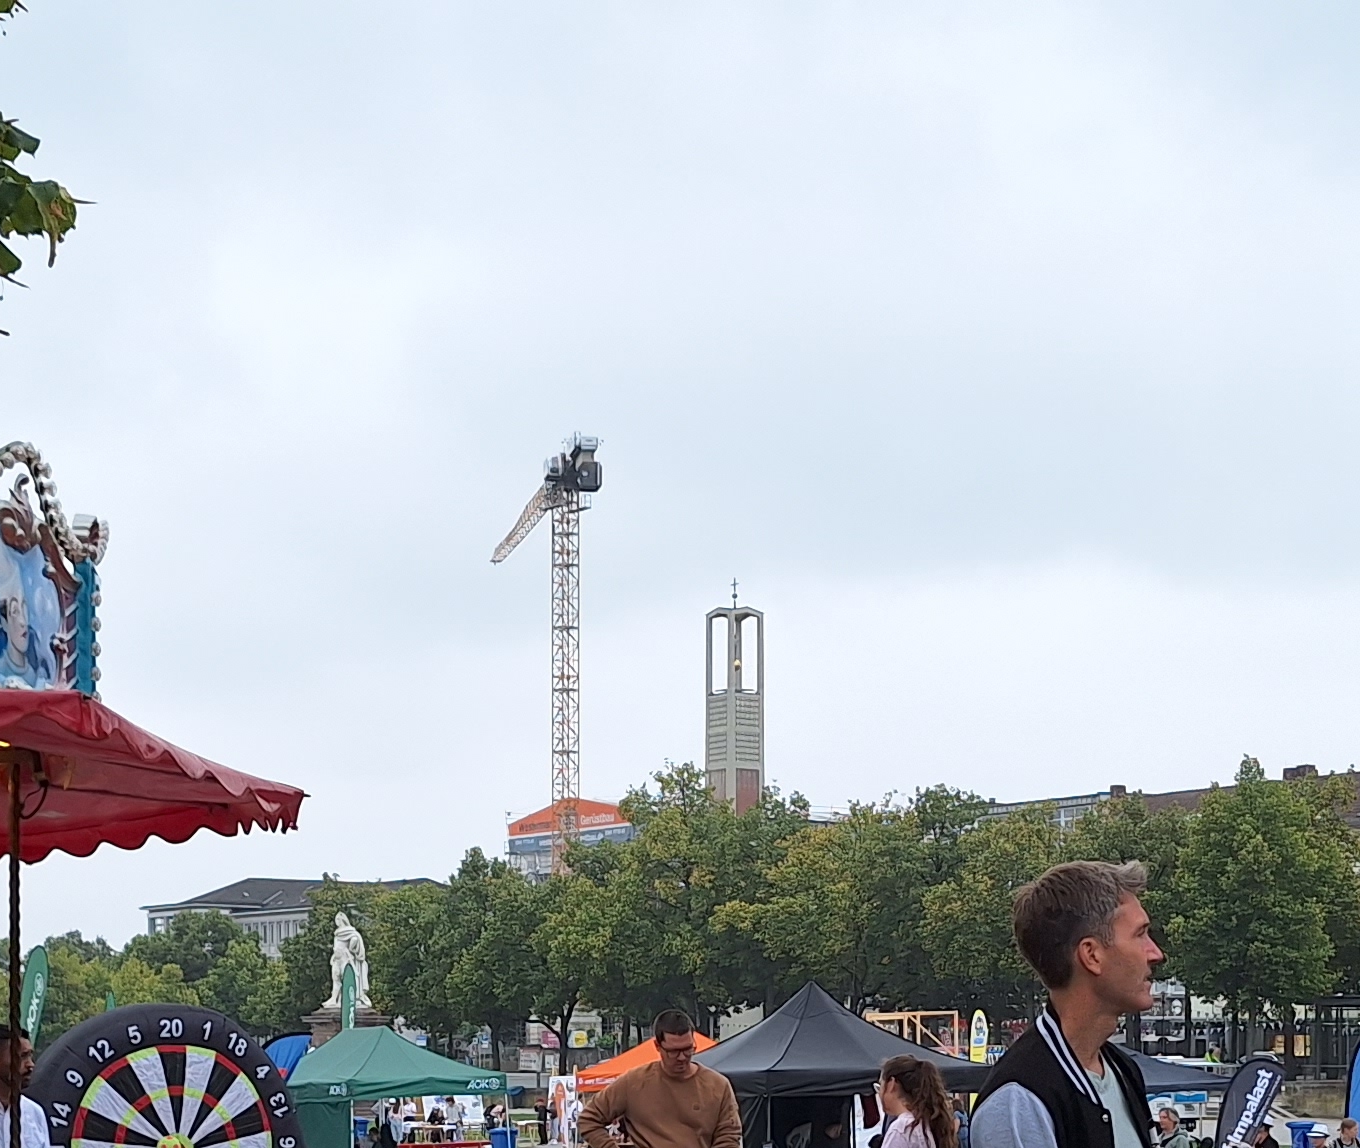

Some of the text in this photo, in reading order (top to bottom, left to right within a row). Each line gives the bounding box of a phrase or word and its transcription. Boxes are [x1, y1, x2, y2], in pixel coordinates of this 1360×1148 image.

[127, 1026, 142, 1045] 5
[159, 1019, 183, 1038] 20
[203, 1021, 213, 1041] 1
[88, 1039, 115, 1063] 12
[227, 1032, 248, 1057] 18
[66, 1069, 84, 1088] 9
[255, 1064, 271, 1080] 4
[467, 1080, 489, 1090] AOK
[50, 1102, 72, 1128] 14
[270, 1093, 289, 1118] 13
